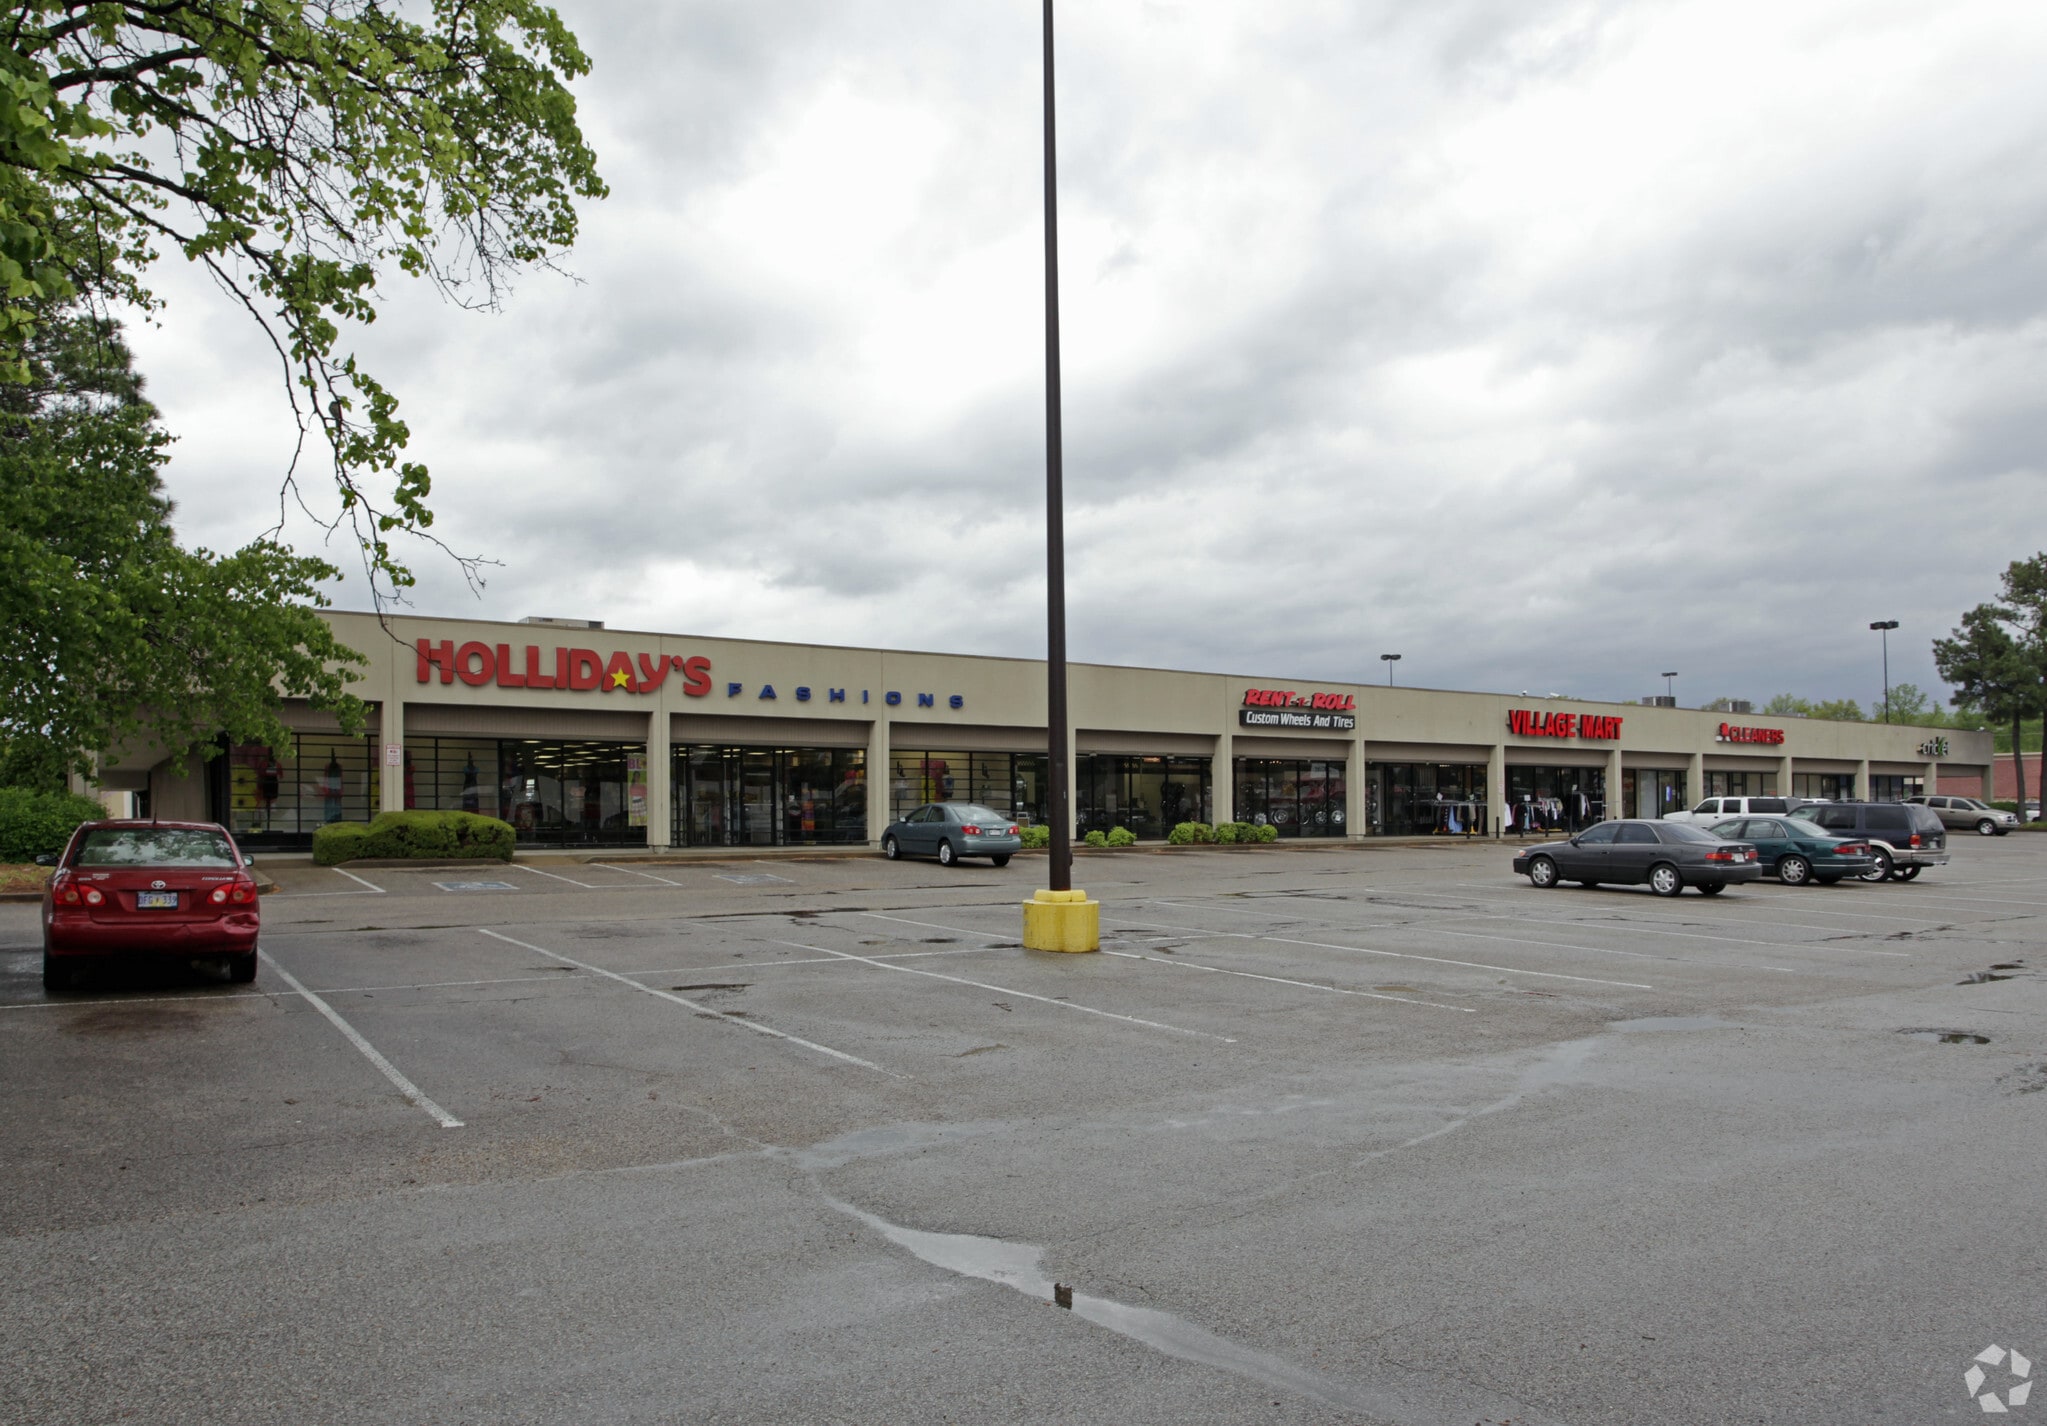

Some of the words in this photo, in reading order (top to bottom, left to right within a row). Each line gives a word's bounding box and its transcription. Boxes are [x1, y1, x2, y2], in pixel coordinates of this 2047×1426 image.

[416, 638, 712, 697] HOLLIDAY'S
[727, 682, 964, 709] FASHIONS
[1244, 688, 1297, 708] RENT
[1312, 692, 1356, 711] ROLL
[1246, 711, 1279, 725] Custom
[1280, 713, 1311, 727] Wheels
[1313, 715, 1331, 728] And
[1333, 716, 1354, 729] Tires
[1508, 709, 1577, 738] VILLAGE
[1580, 714, 1624, 740] MART
[1730, 726, 1785, 745] CLEANERS
